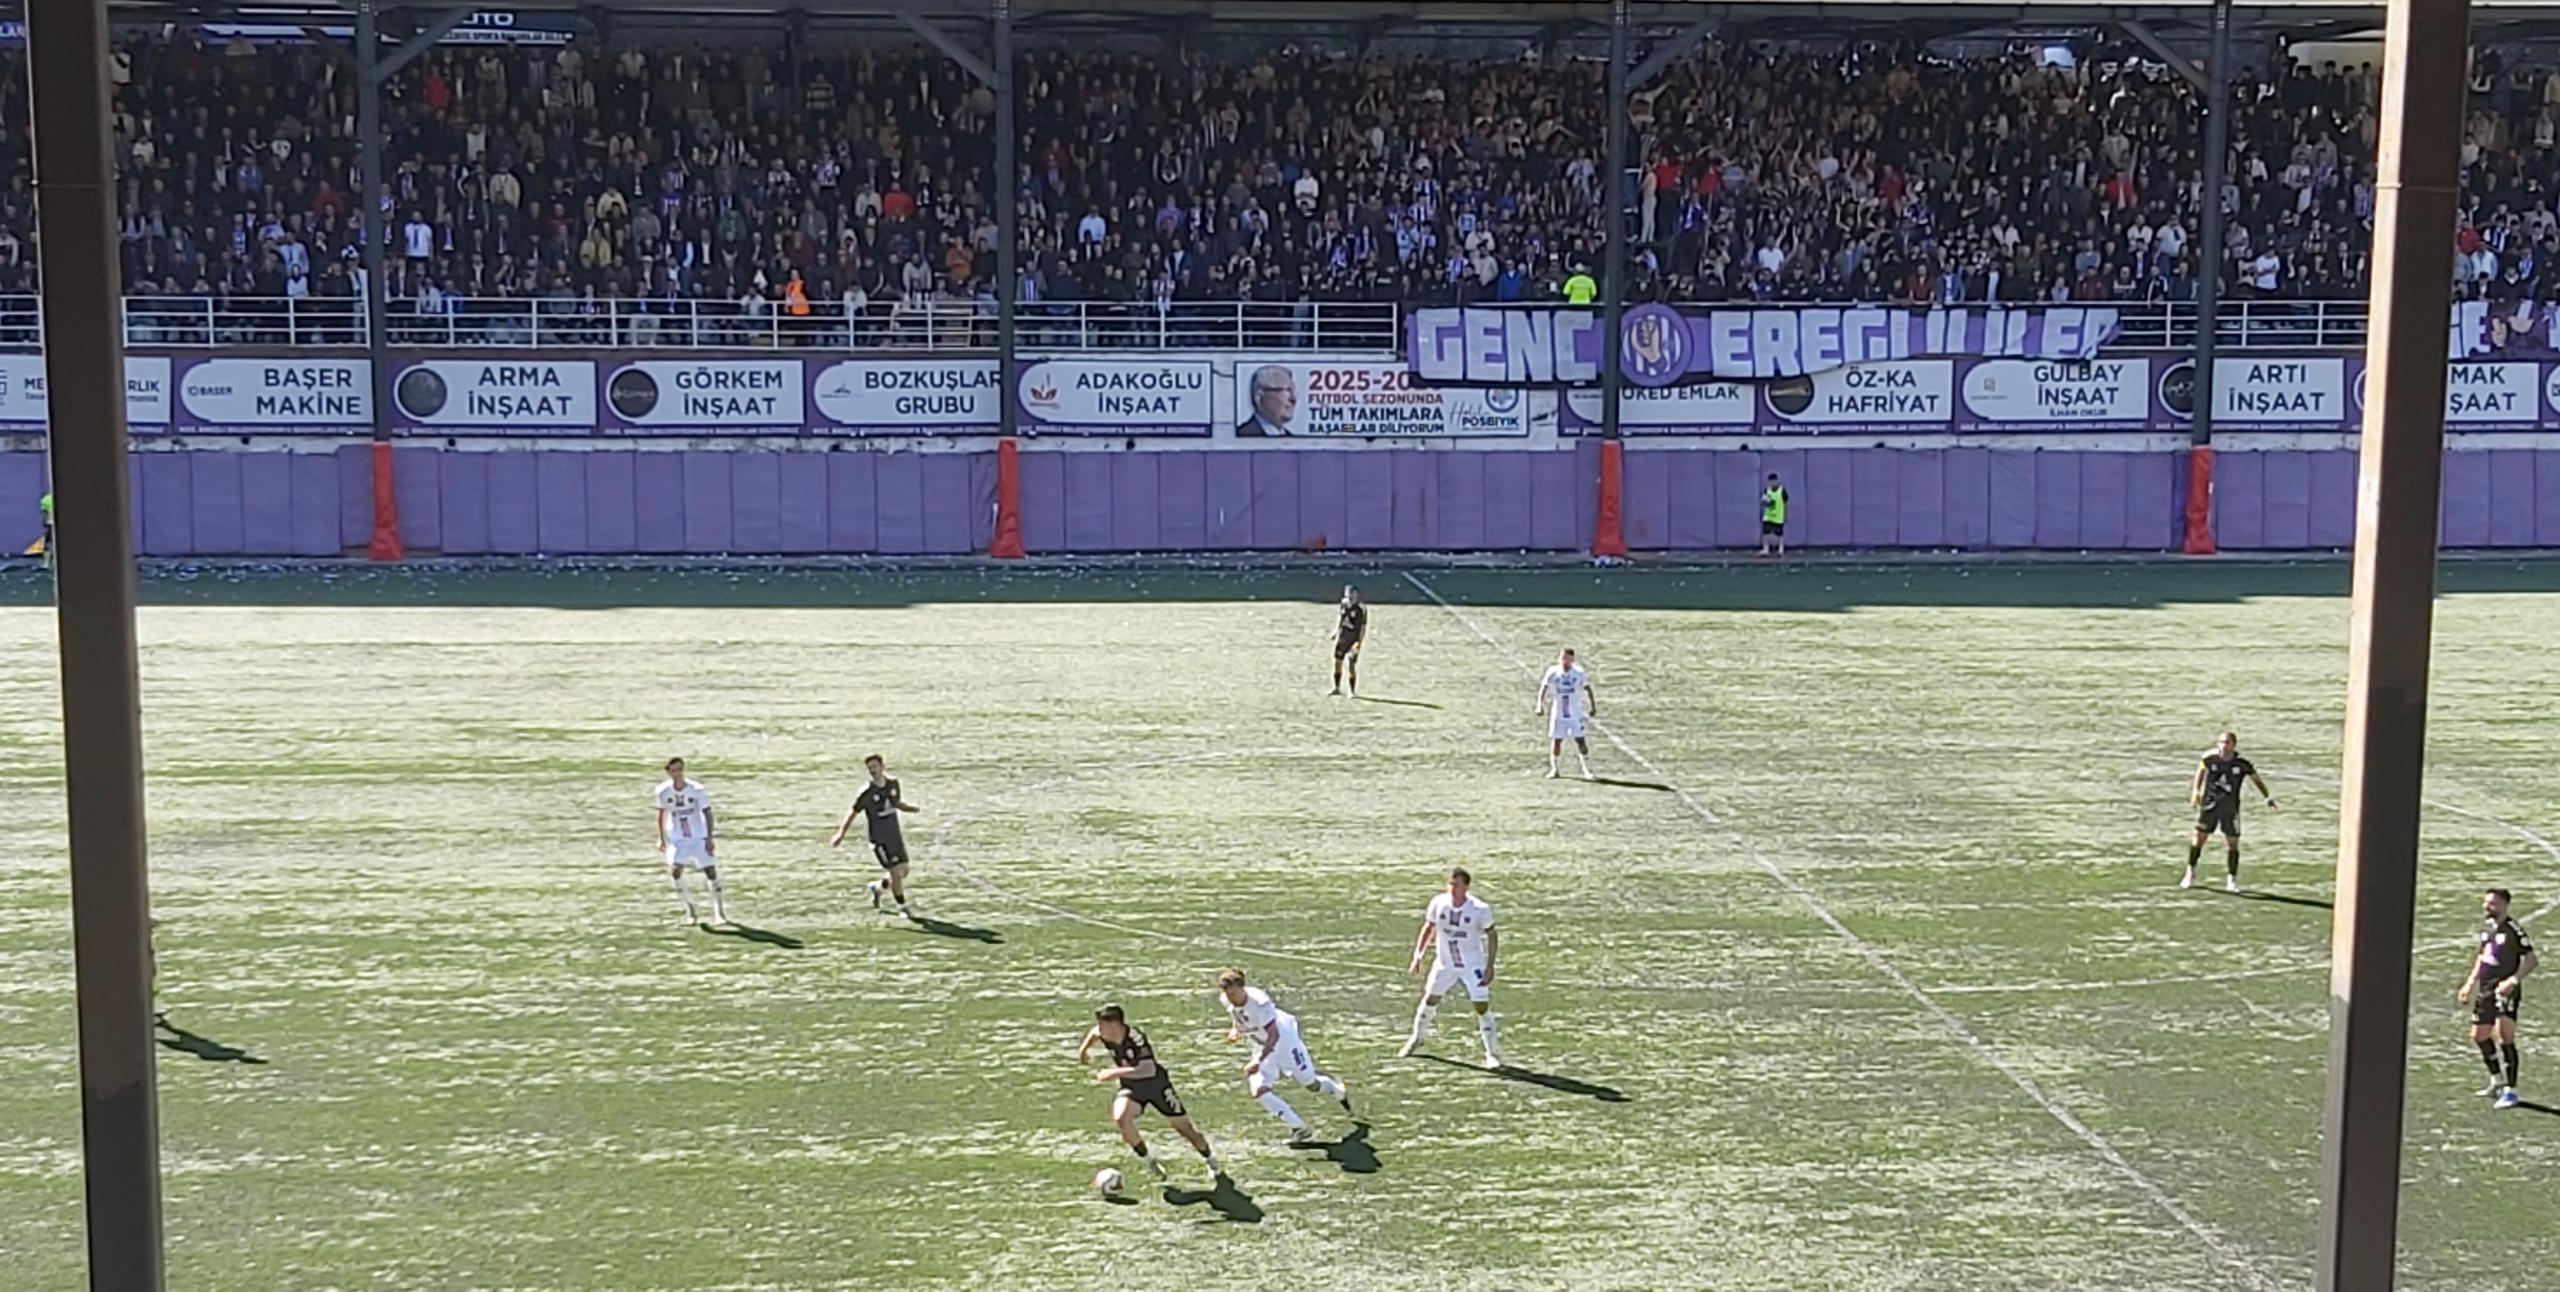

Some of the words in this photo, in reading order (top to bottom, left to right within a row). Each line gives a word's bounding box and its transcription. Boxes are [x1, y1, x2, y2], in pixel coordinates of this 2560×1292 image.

[461, 12, 514, 27] UTO
[264, 367, 354, 392] BAŞER
[478, 366, 561, 387] ARMA
[675, 366, 783, 390] GÖRKEM
[864, 370, 1002, 392] BOZKUŞLAR
[1075, 368, 1203, 391] ADAKOĞLU
[1845, 366, 1917, 389] ÖZ-KA
[2247, 364, 2306, 384] ARTI
[2450, 365, 2506, 385] MAK
[127, 380, 161, 393] RLIK
[1678, 385, 1741, 401] EMLAK
[2037, 383, 2120, 407] İNŞAAT
[256, 394, 362, 417] MAKİNE
[467, 390, 573, 420] İNŞAAT
[683, 391, 777, 419] İNŞAAT
[895, 395, 975, 415] GRUBU
[1098, 391, 1181, 416] İNŞAAT
[1308, 393, 1359, 405] FUTBOL
[1362, 393, 1445, 405] SEZONUNDA
[1828, 391, 1940, 415] HAFRİYAT
[2228, 389, 2326, 416] İNŞAAT
[2449, 392, 2517, 415] ŞAAT
[1308, 405, 1344, 421] TÜM
[1349, 407, 1445, 422] TAKIMLARA
[1308, 423, 1376, 435] BAŞARILAR
[1378, 422, 1445, 434] DİLİYORUM
